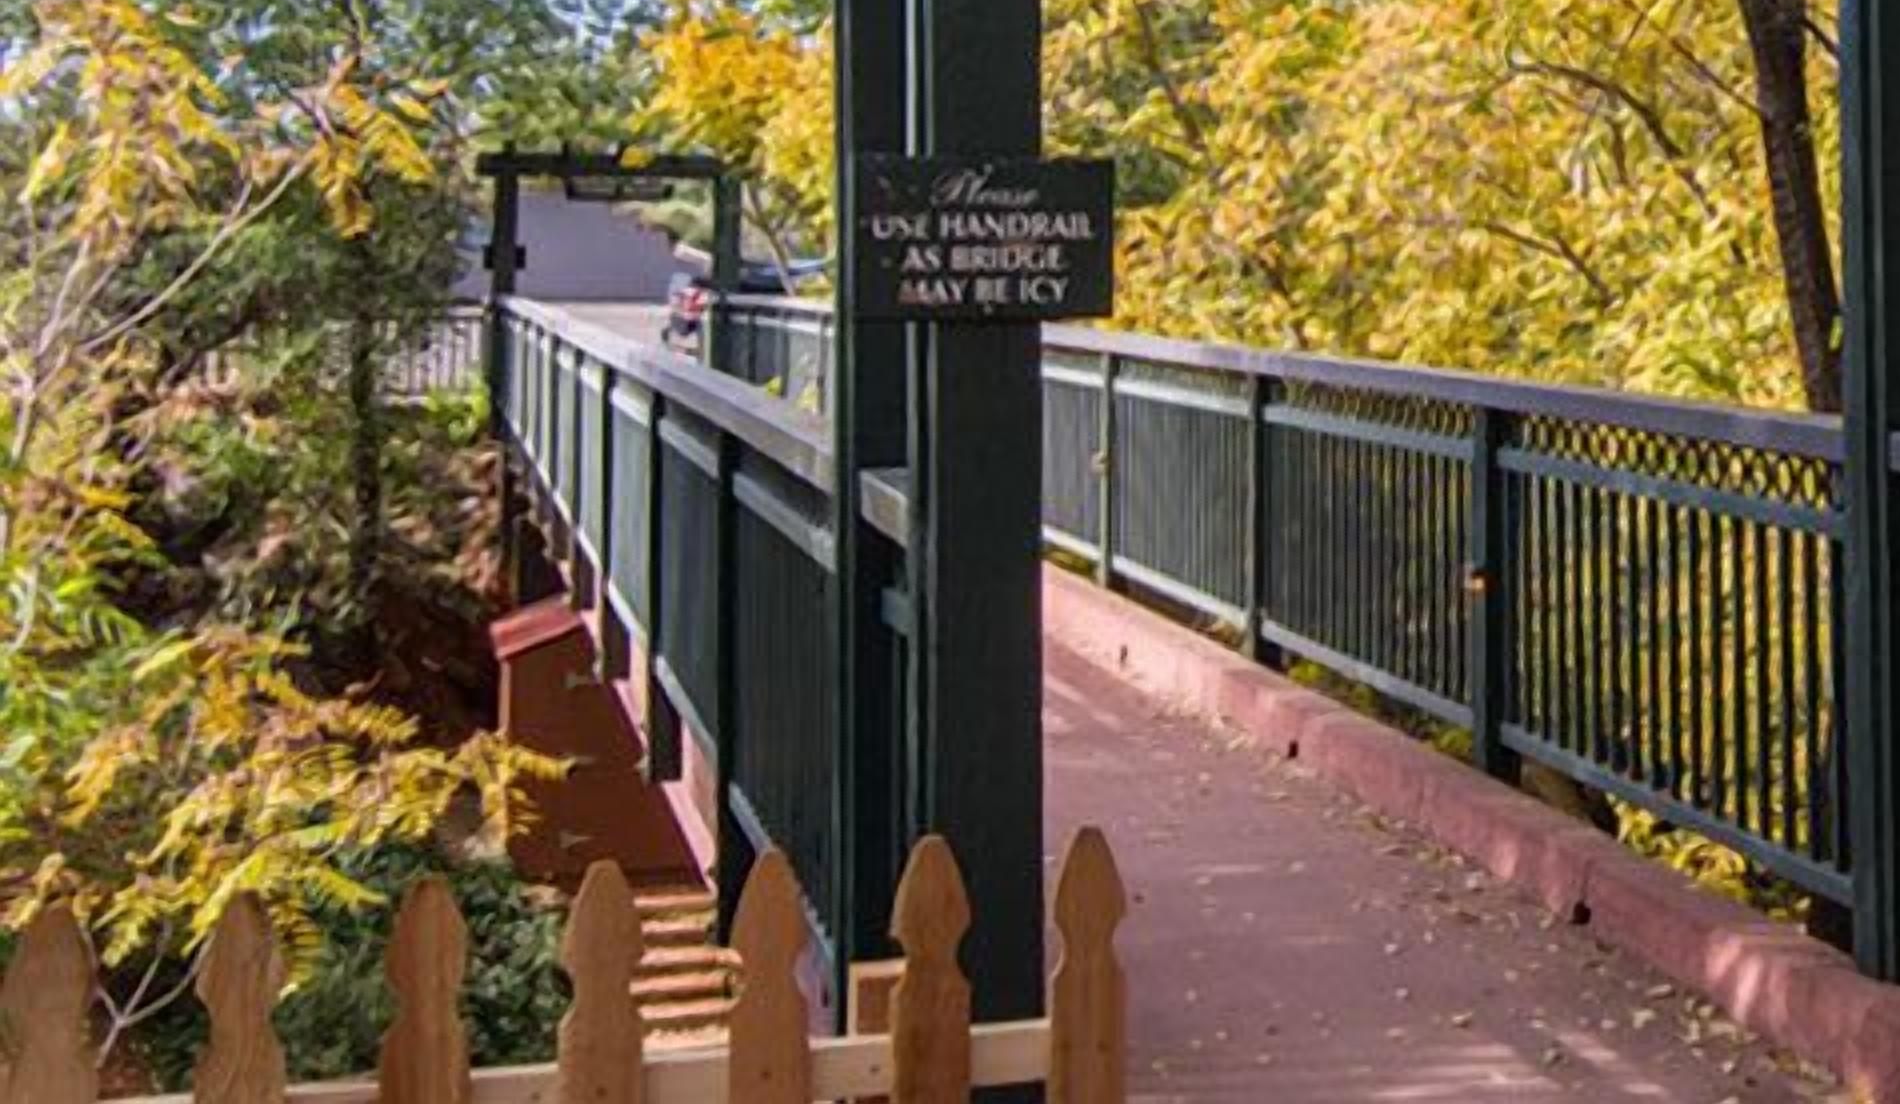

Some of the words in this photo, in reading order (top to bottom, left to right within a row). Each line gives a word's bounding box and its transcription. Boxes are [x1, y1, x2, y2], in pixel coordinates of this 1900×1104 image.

[871, 213, 930, 240] USE
[939, 212, 1094, 240] HANDRAIL
[902, 246, 941, 271] AS
[950, 245, 1067, 270] BRIDGE
[898, 279, 967, 304] MAY
[974, 277, 1009, 303] BE
[1019, 277, 1070, 303] ICY
